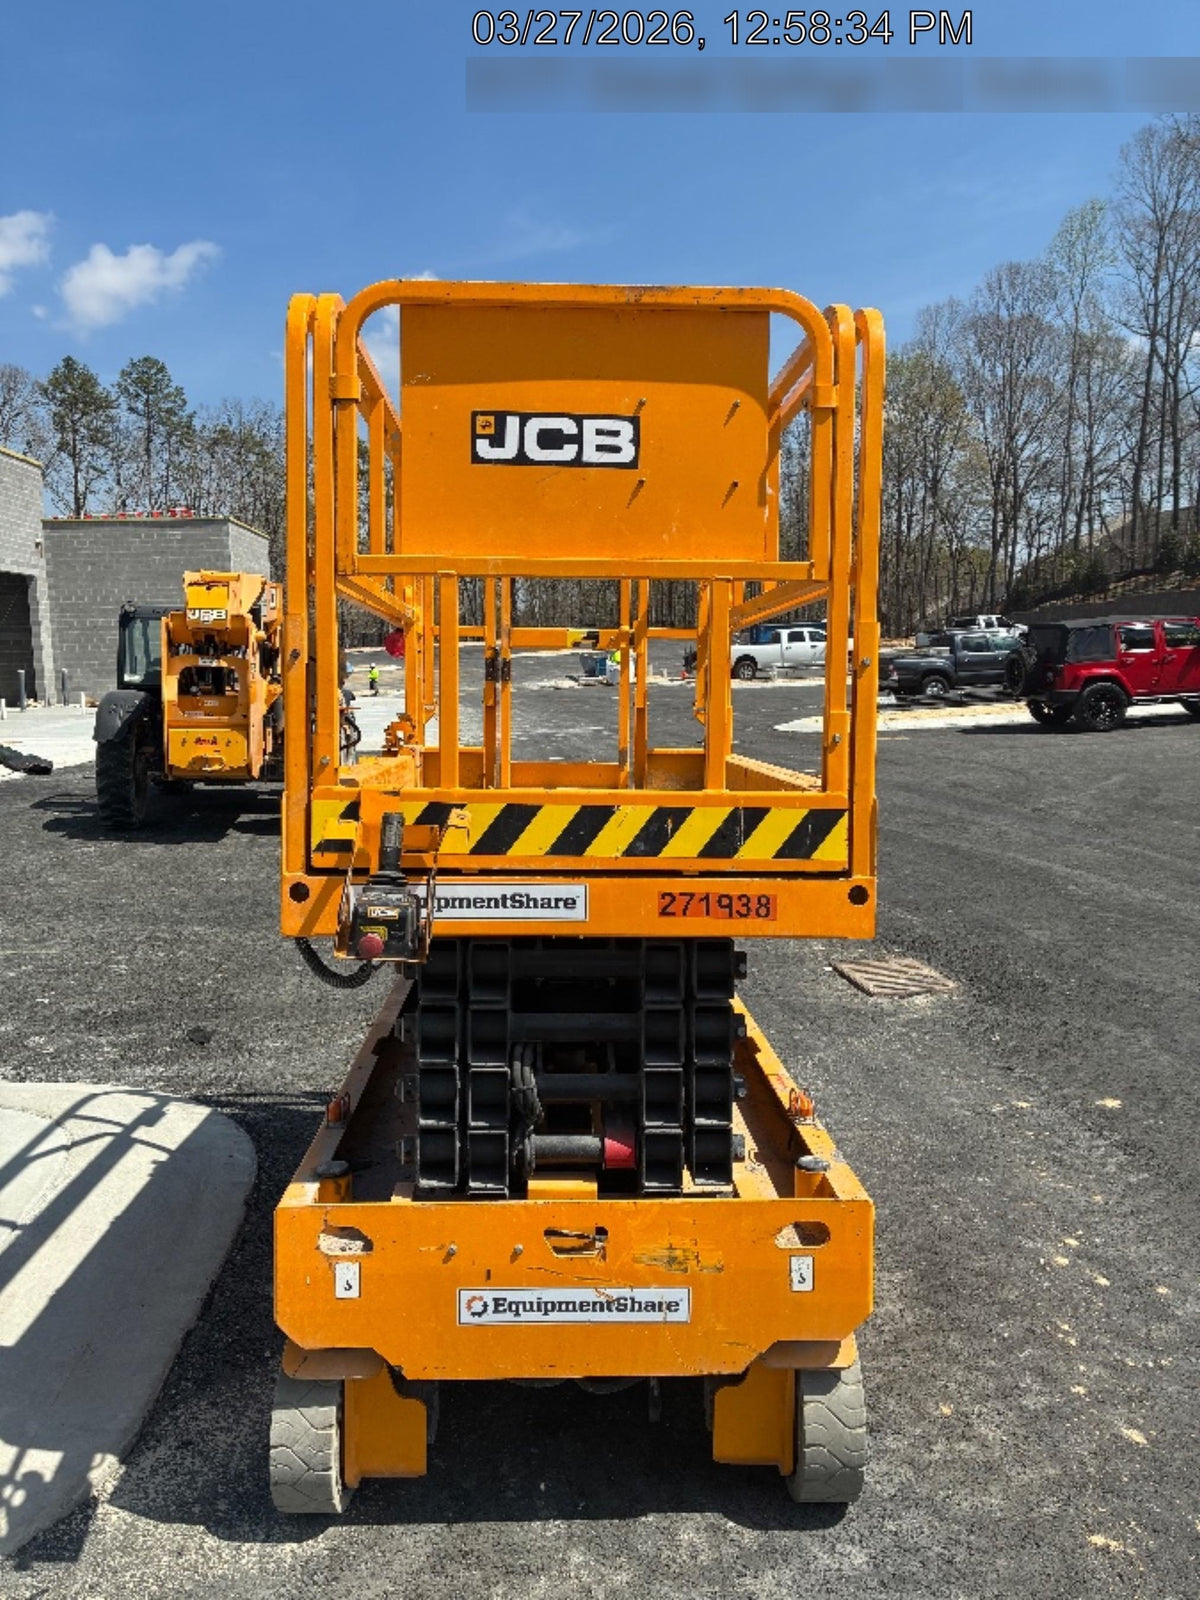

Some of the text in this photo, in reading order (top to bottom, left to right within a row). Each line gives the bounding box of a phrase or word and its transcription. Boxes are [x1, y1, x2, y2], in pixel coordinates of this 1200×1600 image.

[475, 415, 636, 463] JCB
[659, 892, 771, 918] 271938
[492, 1296, 680, 1317] EquipmentShare
